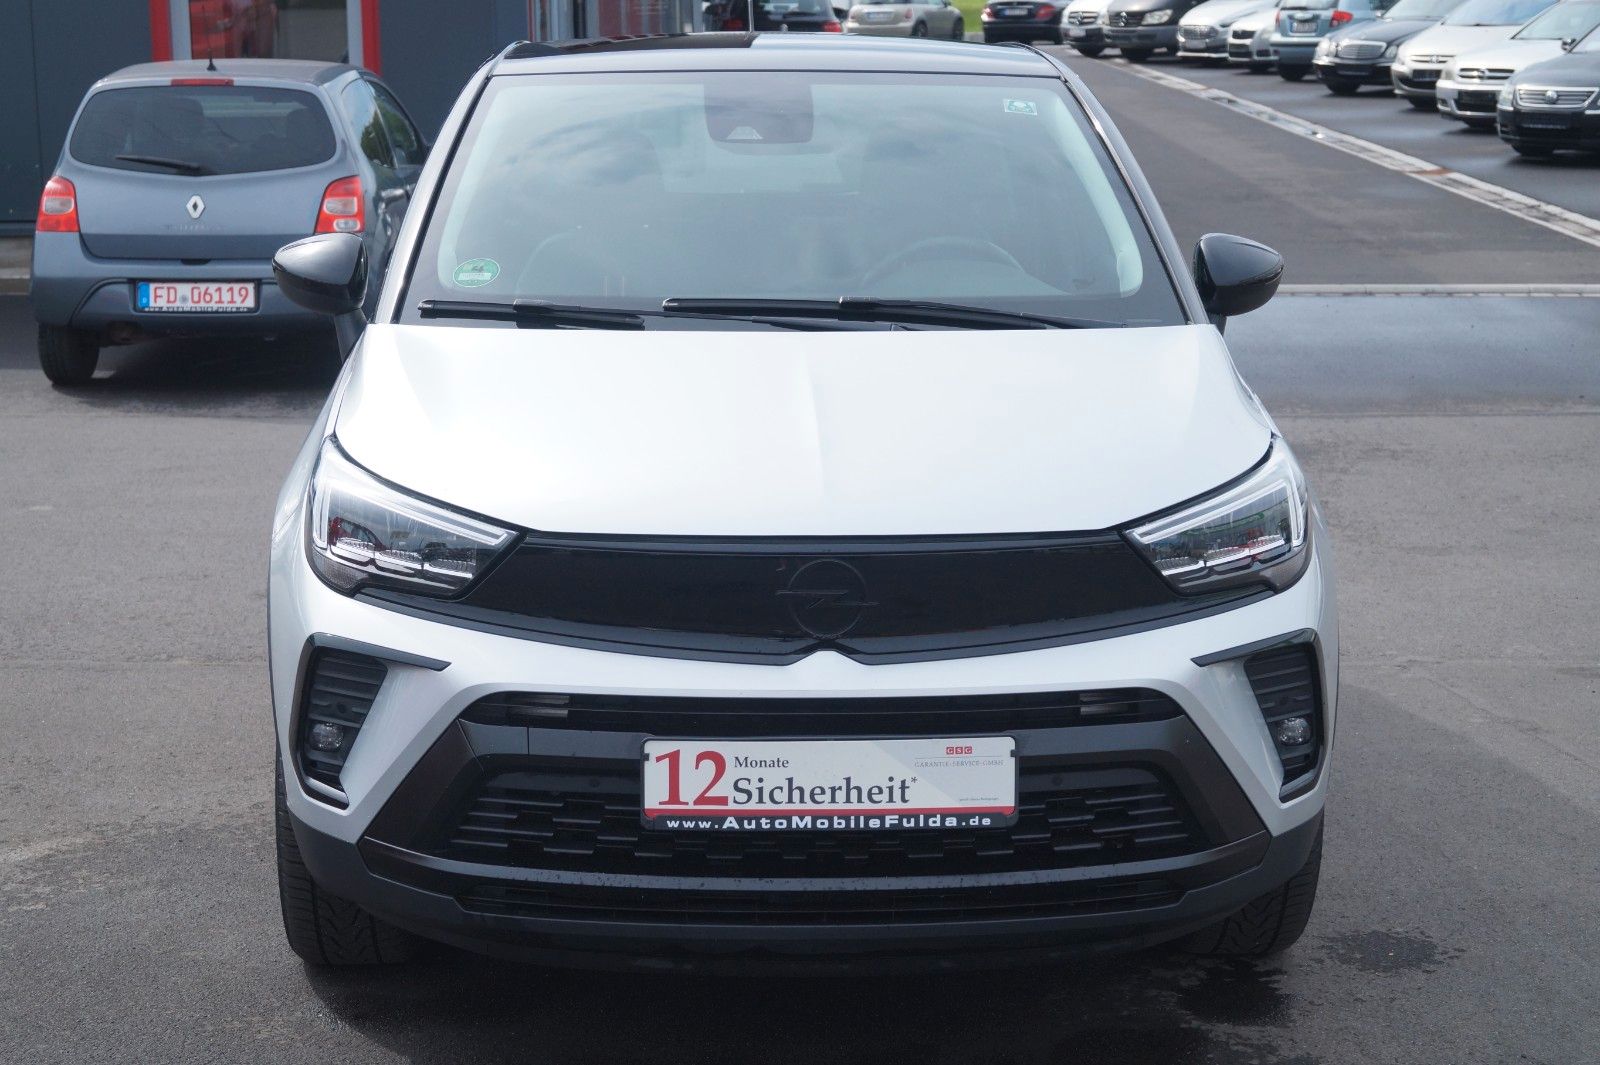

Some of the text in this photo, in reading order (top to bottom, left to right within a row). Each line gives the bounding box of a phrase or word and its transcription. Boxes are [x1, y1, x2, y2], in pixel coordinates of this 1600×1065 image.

[153, 286, 249, 304] FD 06119
[946, 746, 973, 755] GSG
[733, 756, 789, 769] Monate
[655, 748, 729, 806] 12
[666, 814, 992, 830] www.AutoMobileFulda.de
